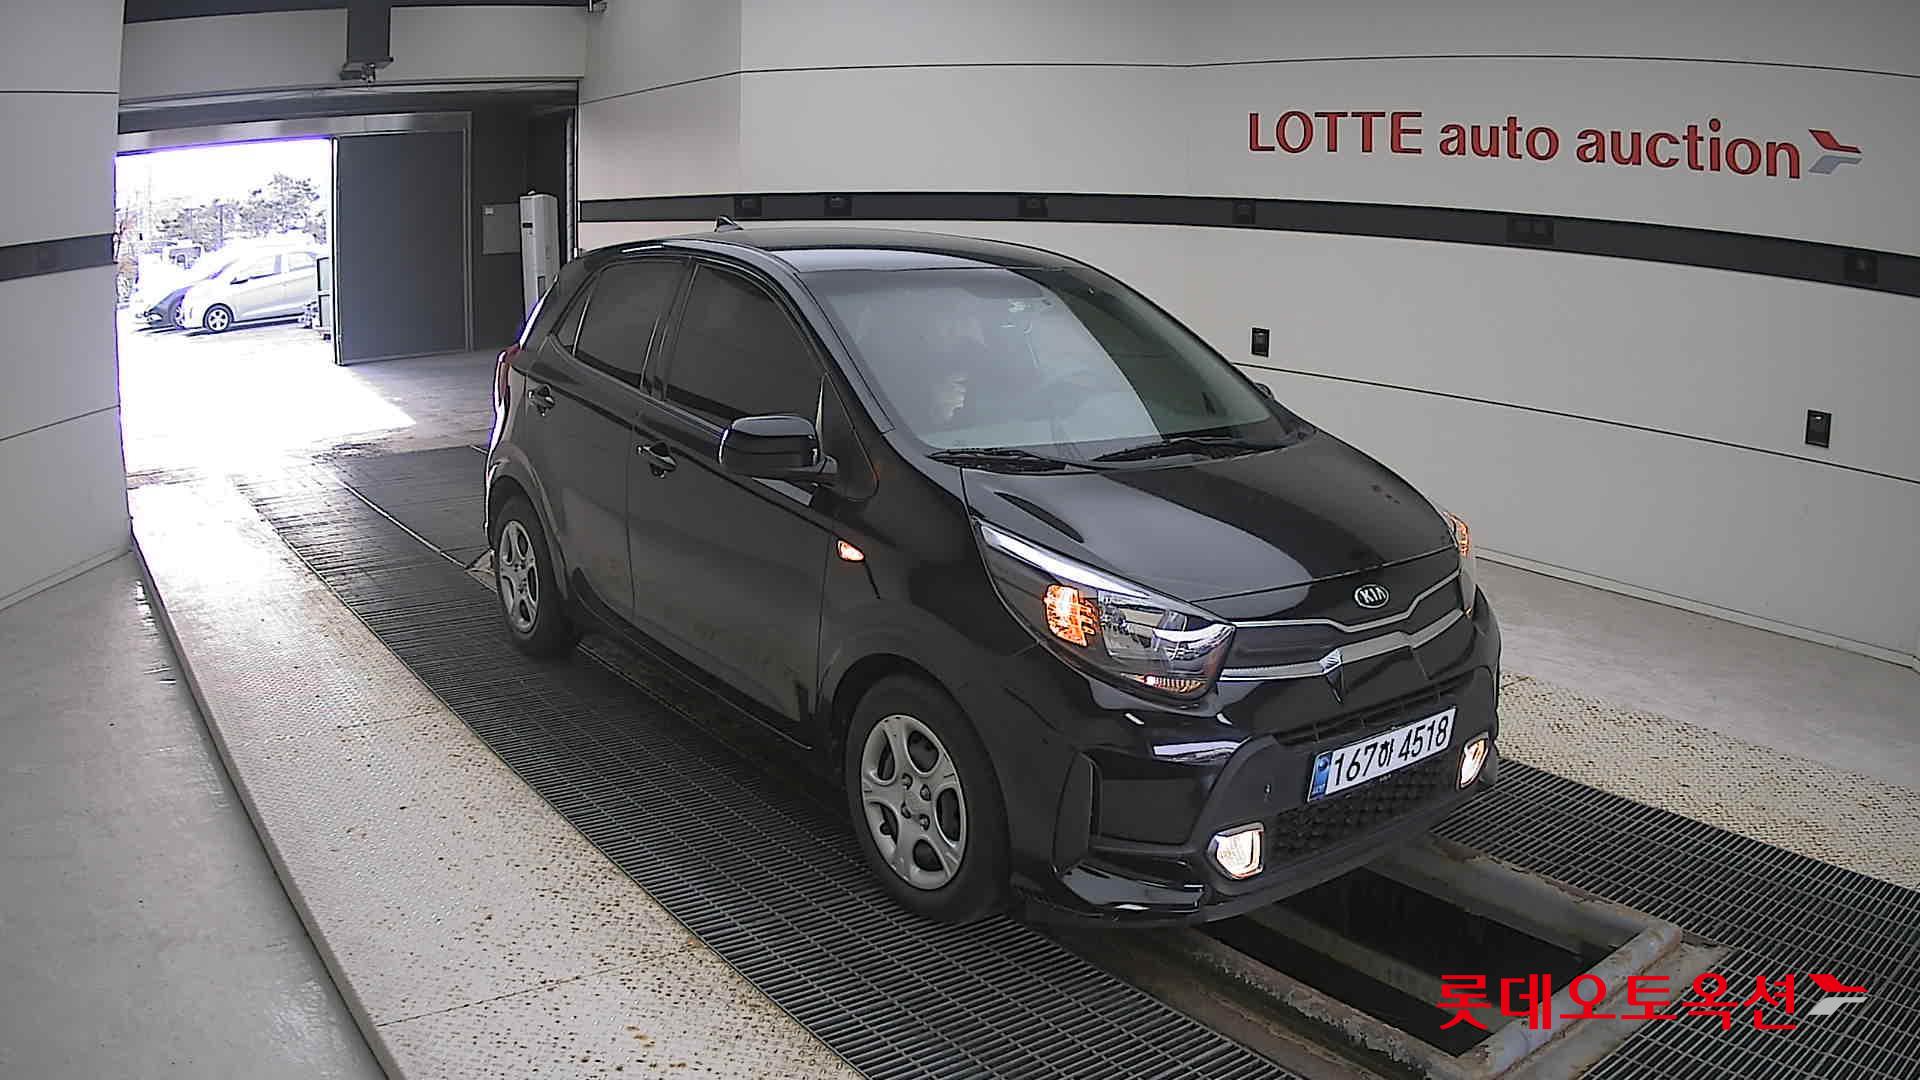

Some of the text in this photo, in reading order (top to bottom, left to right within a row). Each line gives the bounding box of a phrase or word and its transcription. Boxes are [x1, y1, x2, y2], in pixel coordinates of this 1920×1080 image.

[1248, 110, 1801, 180] LOTTE auto auction
[1360, 587, 1386, 604] KIA
[1398, 716, 1449, 761] 4518
